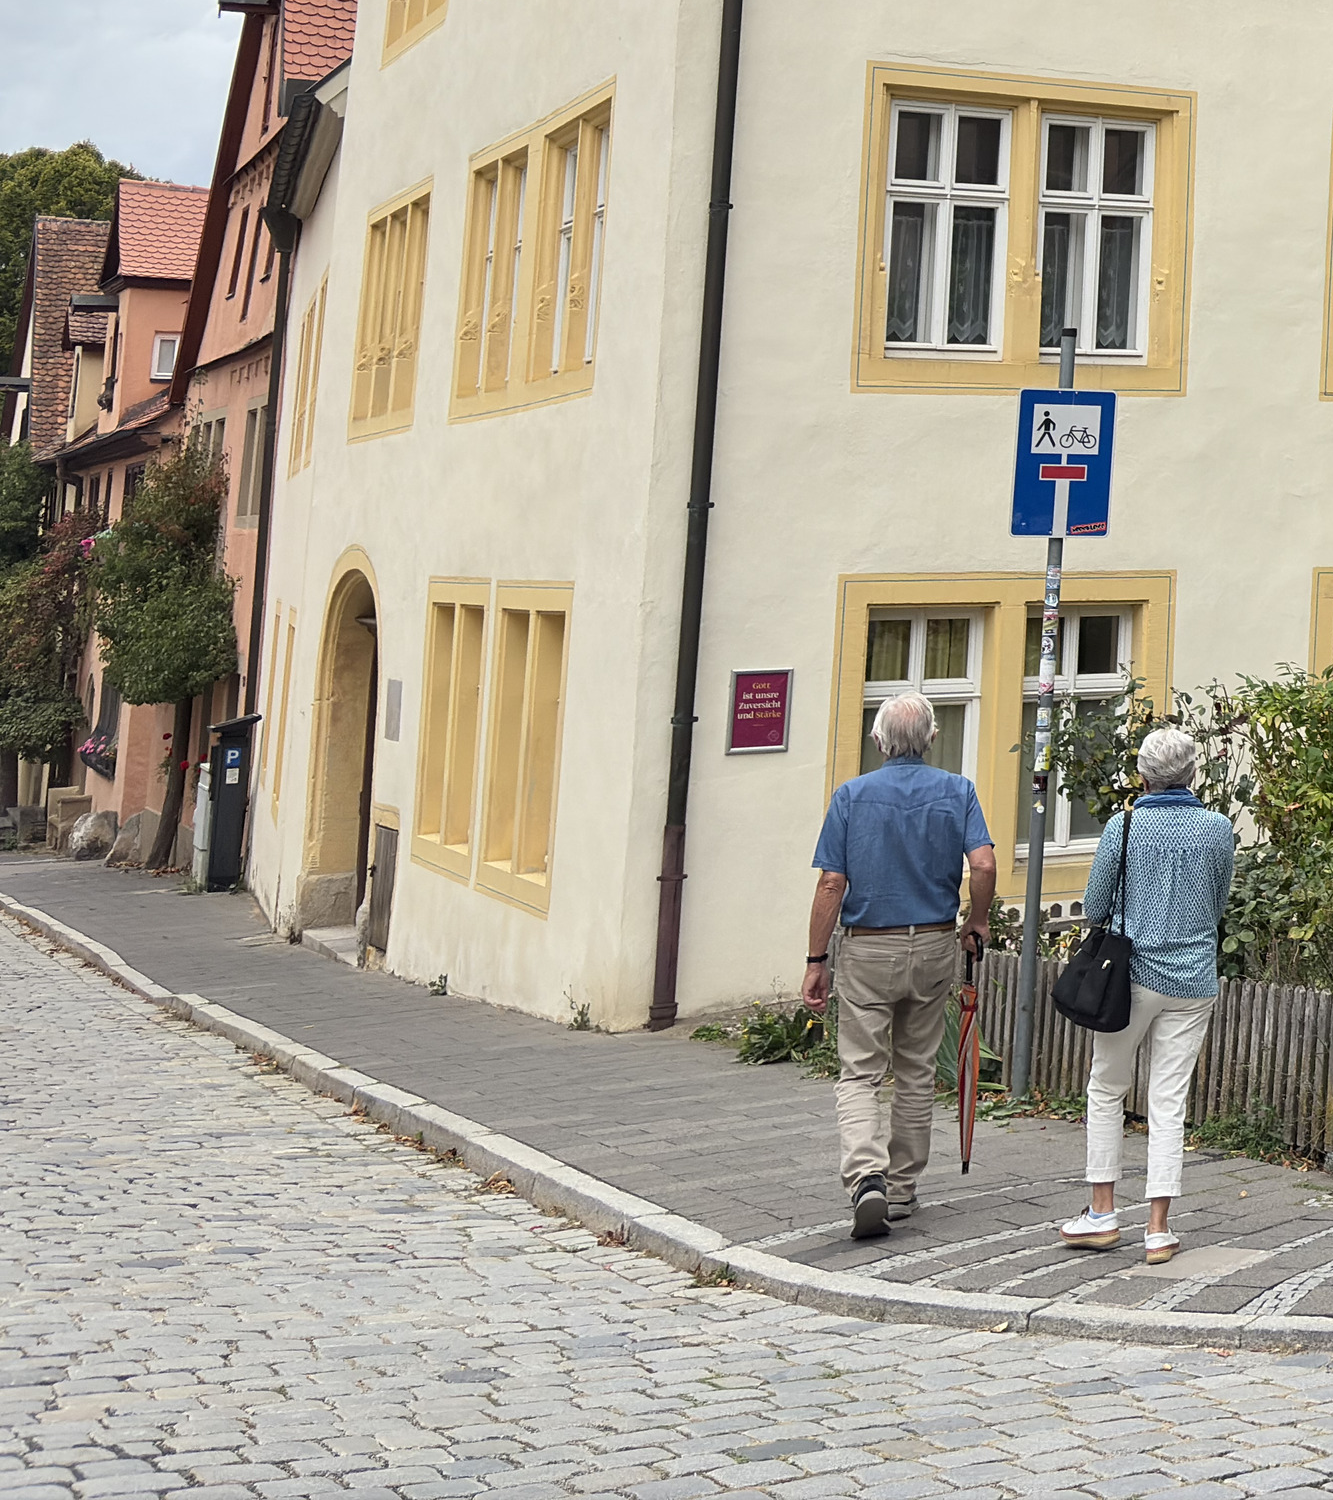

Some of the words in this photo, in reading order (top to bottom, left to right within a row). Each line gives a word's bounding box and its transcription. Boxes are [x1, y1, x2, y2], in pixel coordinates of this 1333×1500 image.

[738, 700, 781, 710] Zuversicht
[737, 711, 754, 719] und
[755, 710, 782, 718] Stärke
[227, 750, 239, 764] P
